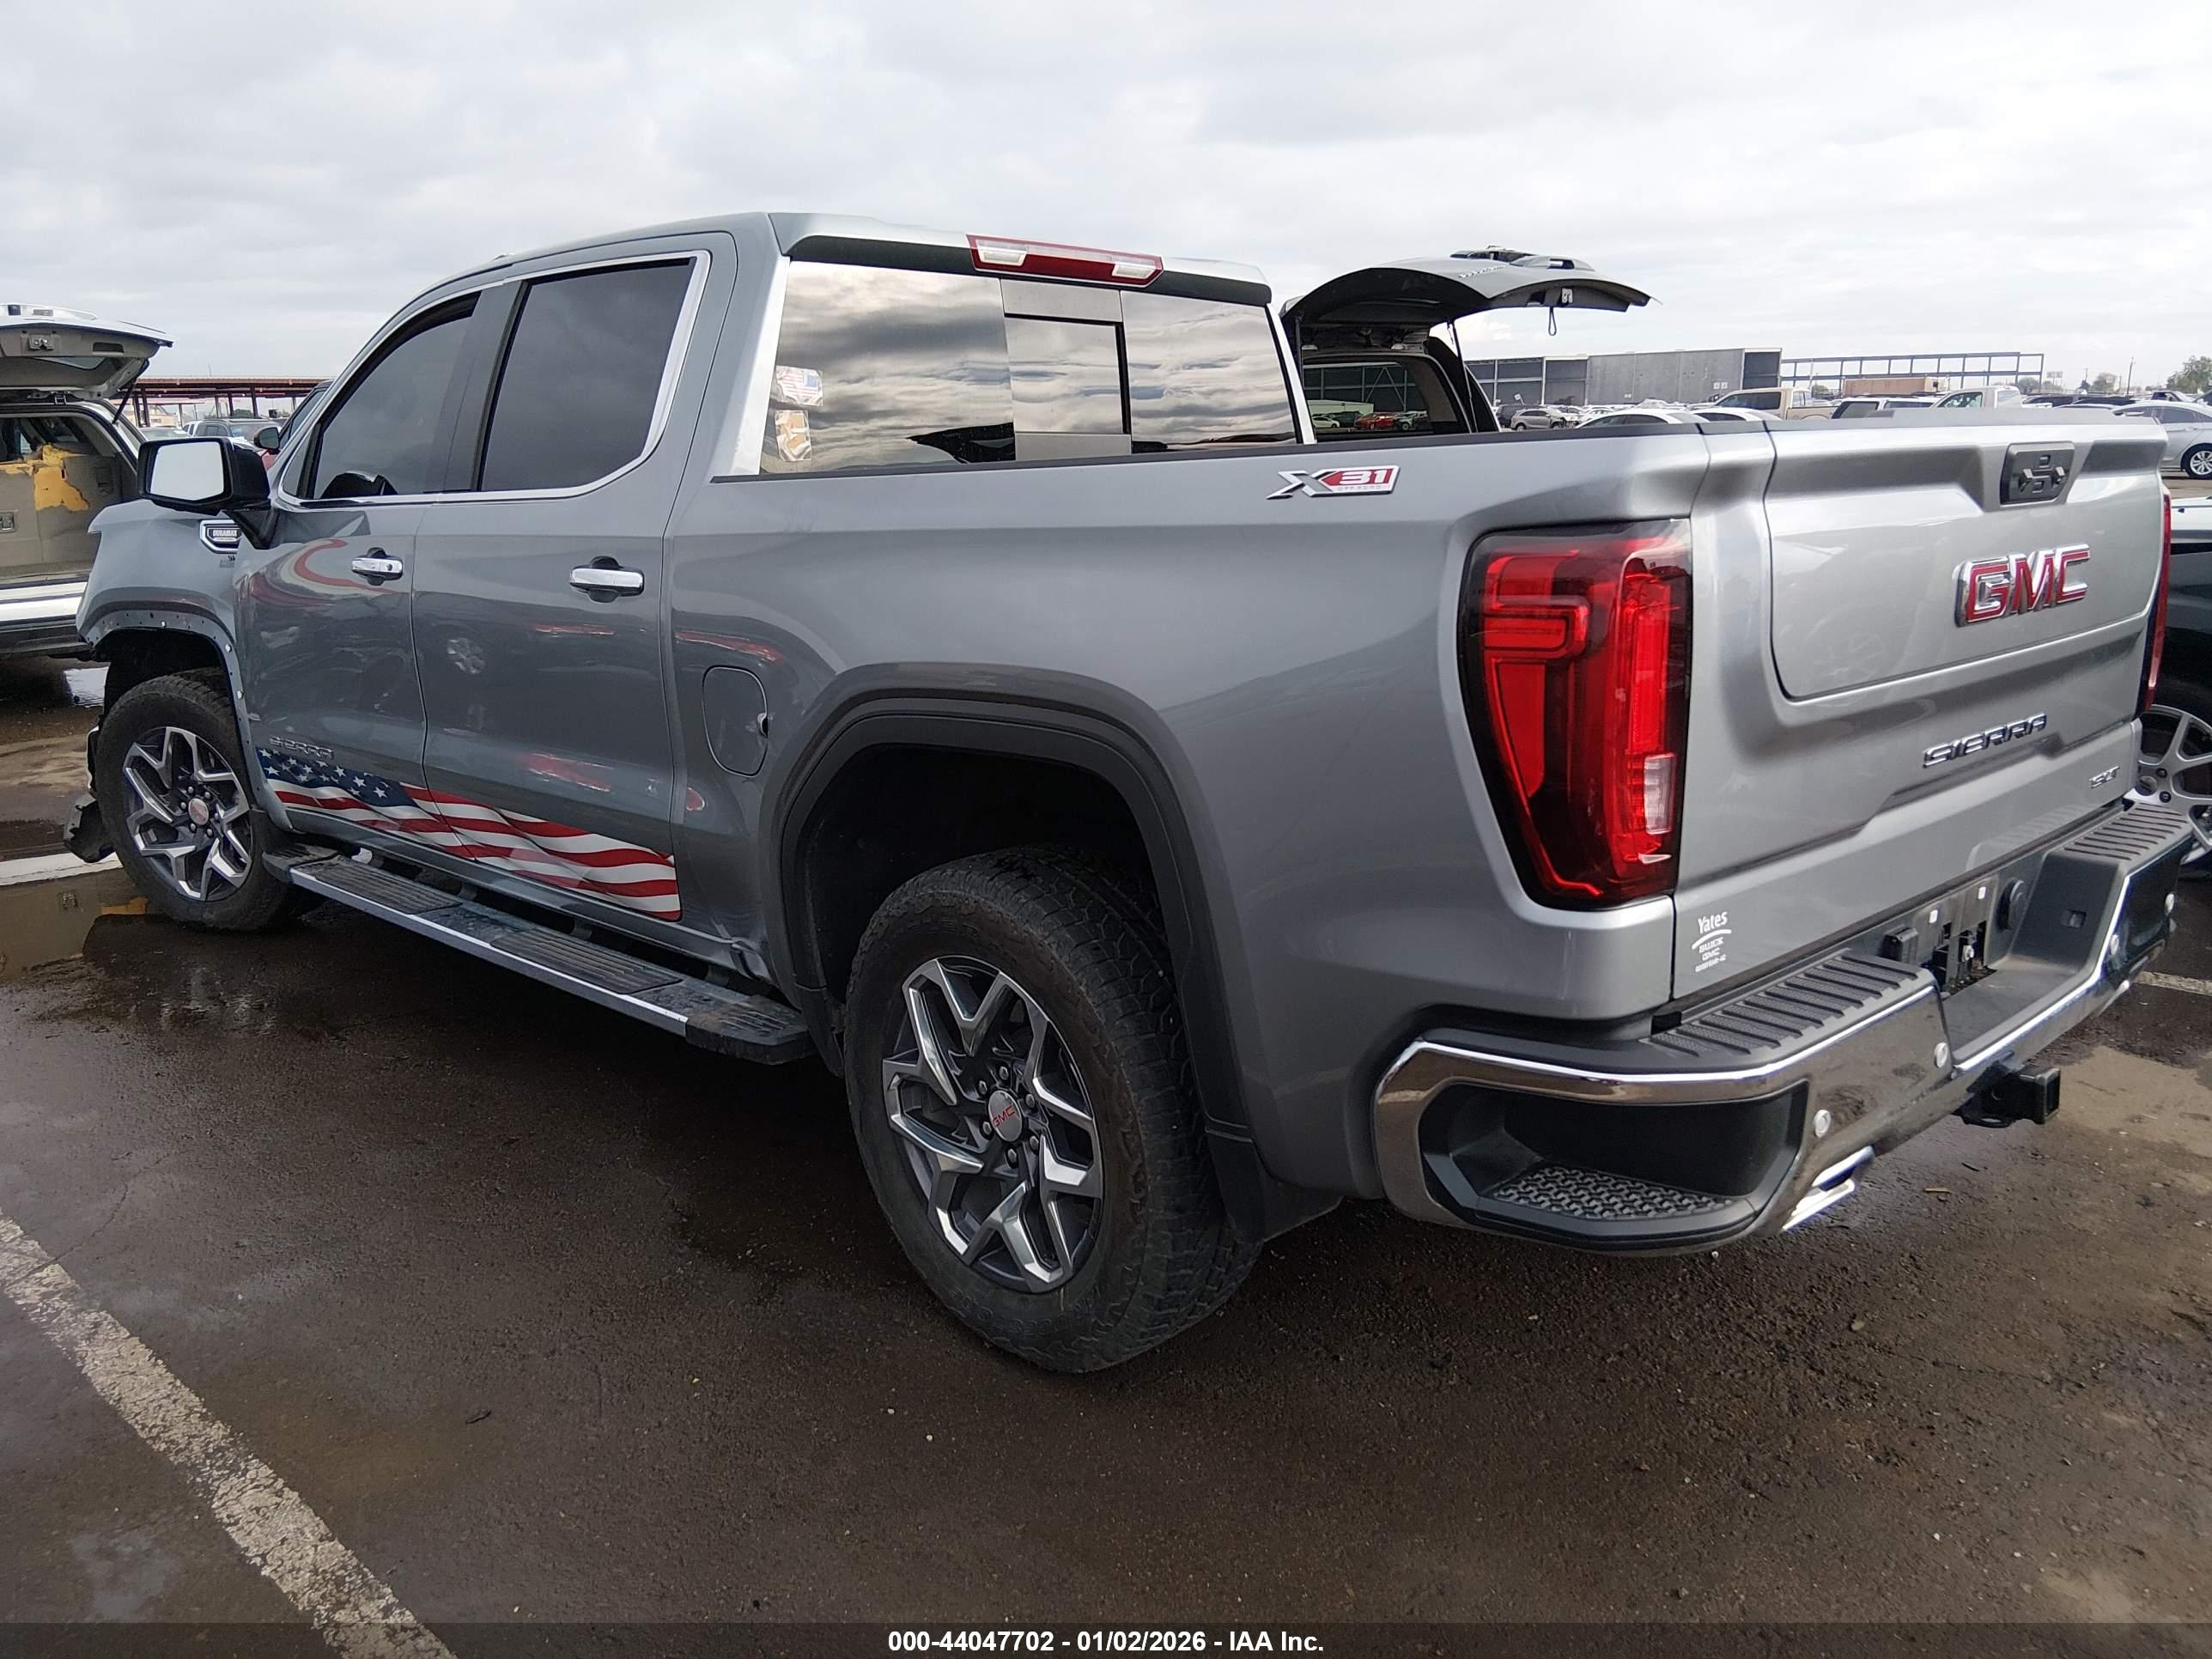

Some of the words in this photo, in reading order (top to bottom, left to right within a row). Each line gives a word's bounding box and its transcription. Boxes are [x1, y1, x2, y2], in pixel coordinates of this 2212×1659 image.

[1953, 544, 2091, 628] GMC
[268, 735, 334, 760] SIERRA
[1922, 713, 2047, 769] SIERRA
[2088, 765, 2120, 789] SLT
[1698, 911, 1728, 933] Yates
[1698, 936, 1725, 953] BUICK
[1702, 947, 1721, 961] GMC
[993, 1103, 1017, 1127] GMC
